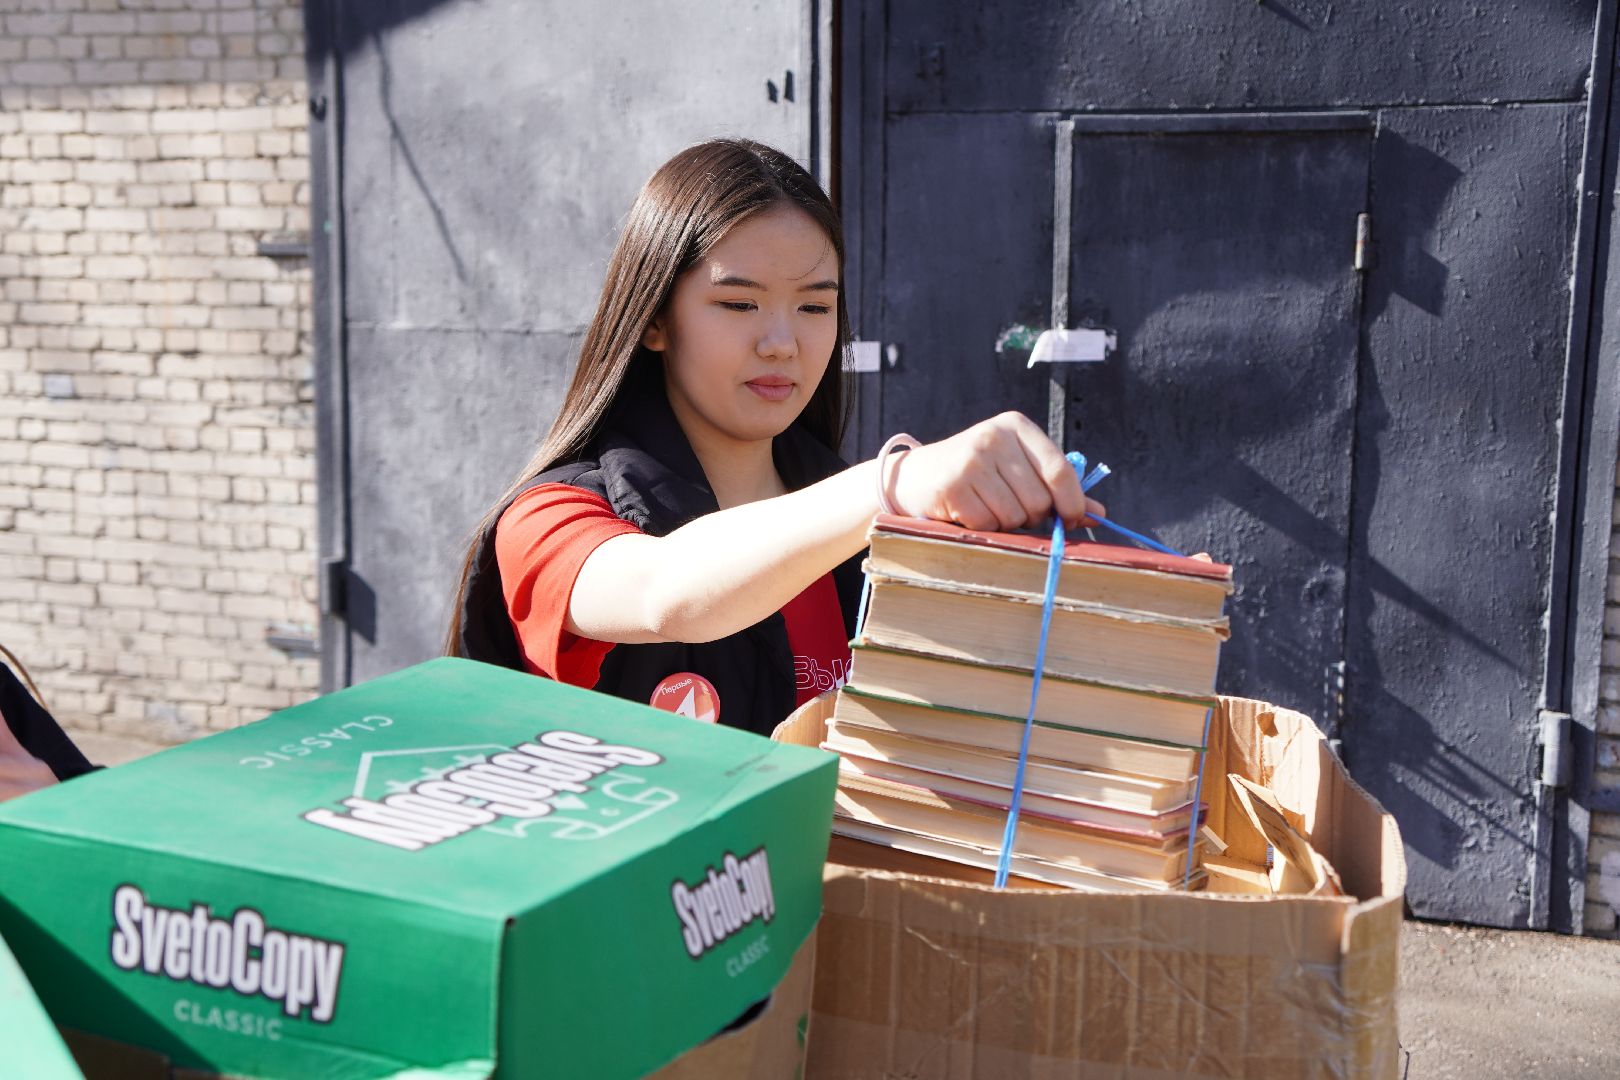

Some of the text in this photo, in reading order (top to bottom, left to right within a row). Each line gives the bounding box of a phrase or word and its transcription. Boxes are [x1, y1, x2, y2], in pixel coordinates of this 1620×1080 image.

[660, 678, 693, 696] Первые
[239, 715, 394, 770] CLASSIC
[301, 730, 664, 850] SvetoCopy
[672, 846, 775, 959] SvetoCopy
[110, 882, 346, 1024] SvetoCopy
[726, 934, 770, 978] CLASSIC
[173, 998, 283, 1041] CLASSIC
